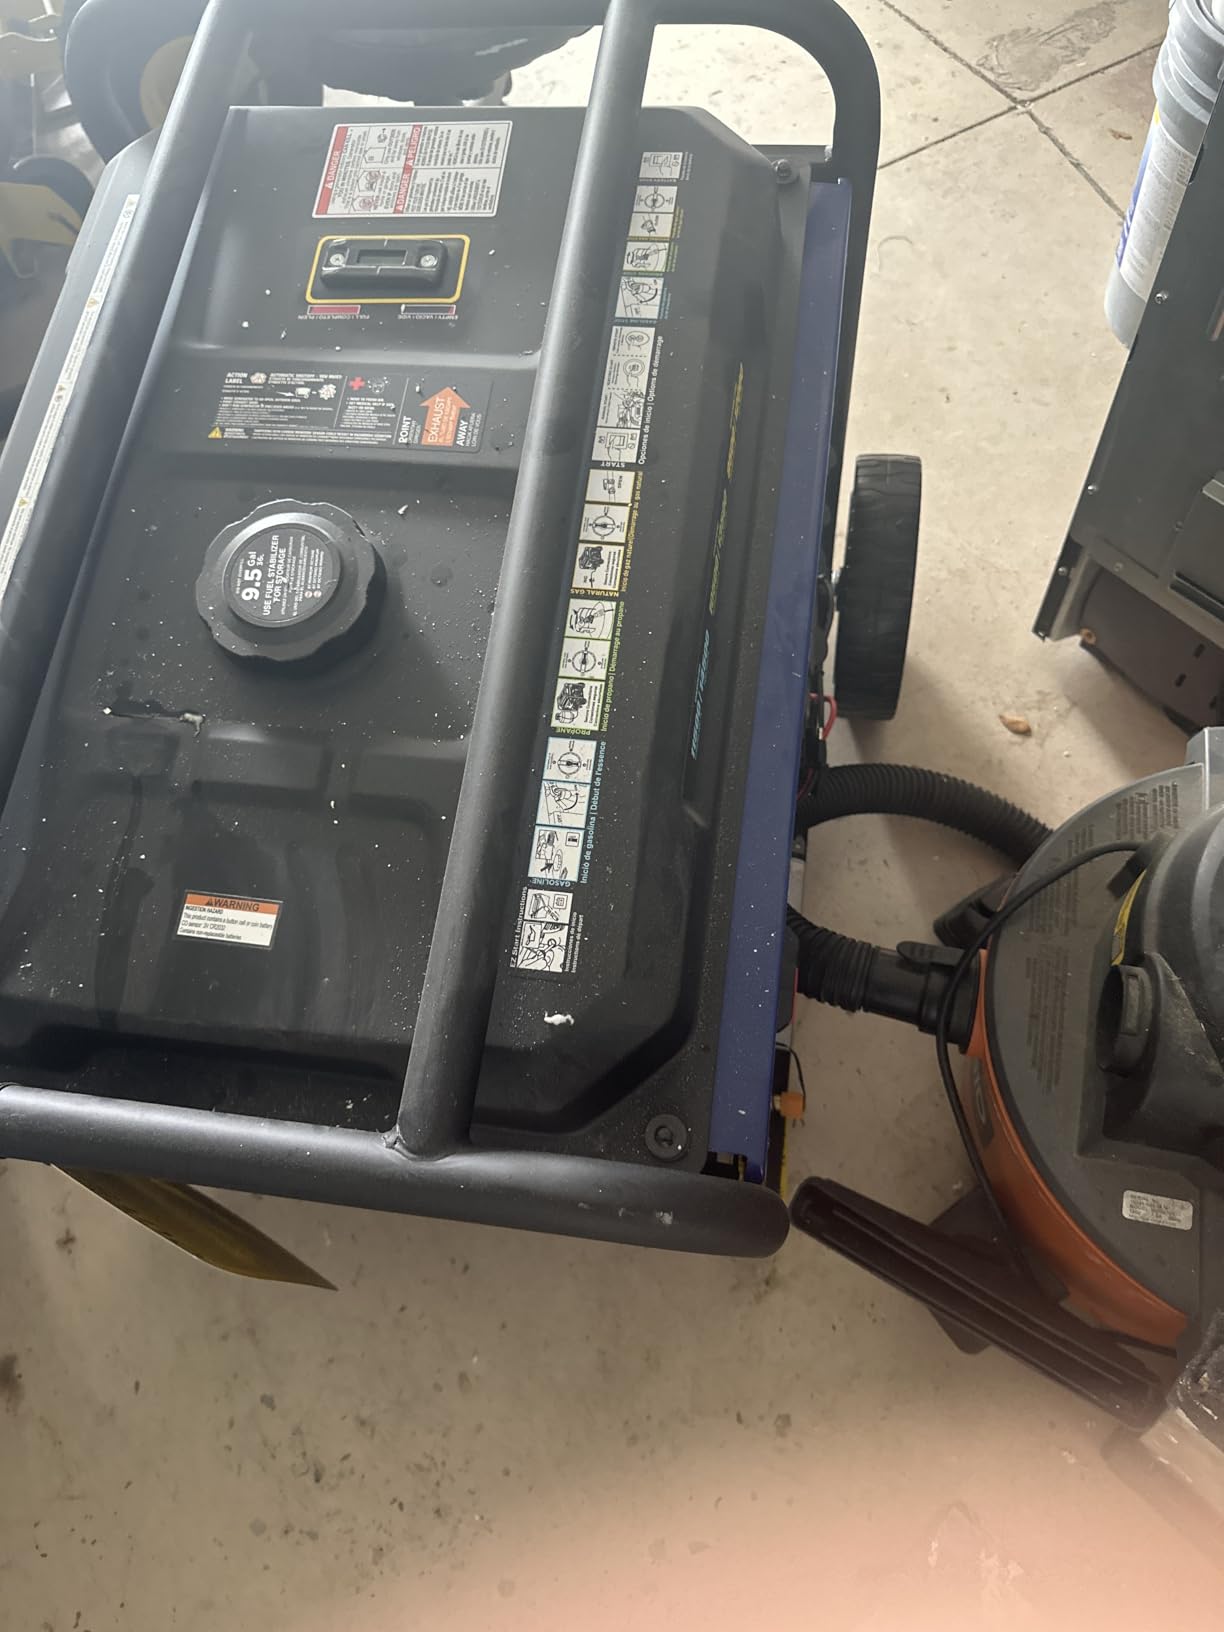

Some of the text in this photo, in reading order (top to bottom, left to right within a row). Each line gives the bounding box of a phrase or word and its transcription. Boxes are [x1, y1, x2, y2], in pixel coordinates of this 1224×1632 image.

[409, 127, 419, 157] PELIGRO
[329, 150, 340, 180] DANGER
[398, 173, 409, 205] DANGER
[647, 377, 657, 401] Options
[428, 396, 445, 442] EXHAUST
[645, 407, 653, 423] inicio
[398, 416, 412, 443] POINT
[456, 420, 468, 446] AWAY
[643, 425, 649, 433] de
[639, 434, 648, 464] Opciones
[241, 551, 262, 600] 9.5 Gal
[263, 535, 279, 615] USE FUEL STABILIZER
[273, 547, 286, 603] FOR STORAGE
[616, 602, 624, 627] propane
[615, 628, 620, 636] au
[605, 676, 614, 703] propano
[604, 704, 610, 712] de
[601, 714, 609, 731] Inicio
[594, 777, 601, 786] de
[587, 817, 596, 849] gasolina
[585, 850, 591, 860] de
[532, 878, 571, 887] GASOLINE
[214, 898, 260, 912] WARNING
[260, 921, 272, 929] battery
[510, 886, 527, 968] EZ Start Instructions
[565, 936, 574, 972] Instrucciones
[572, 941, 580, 973] Instructions
